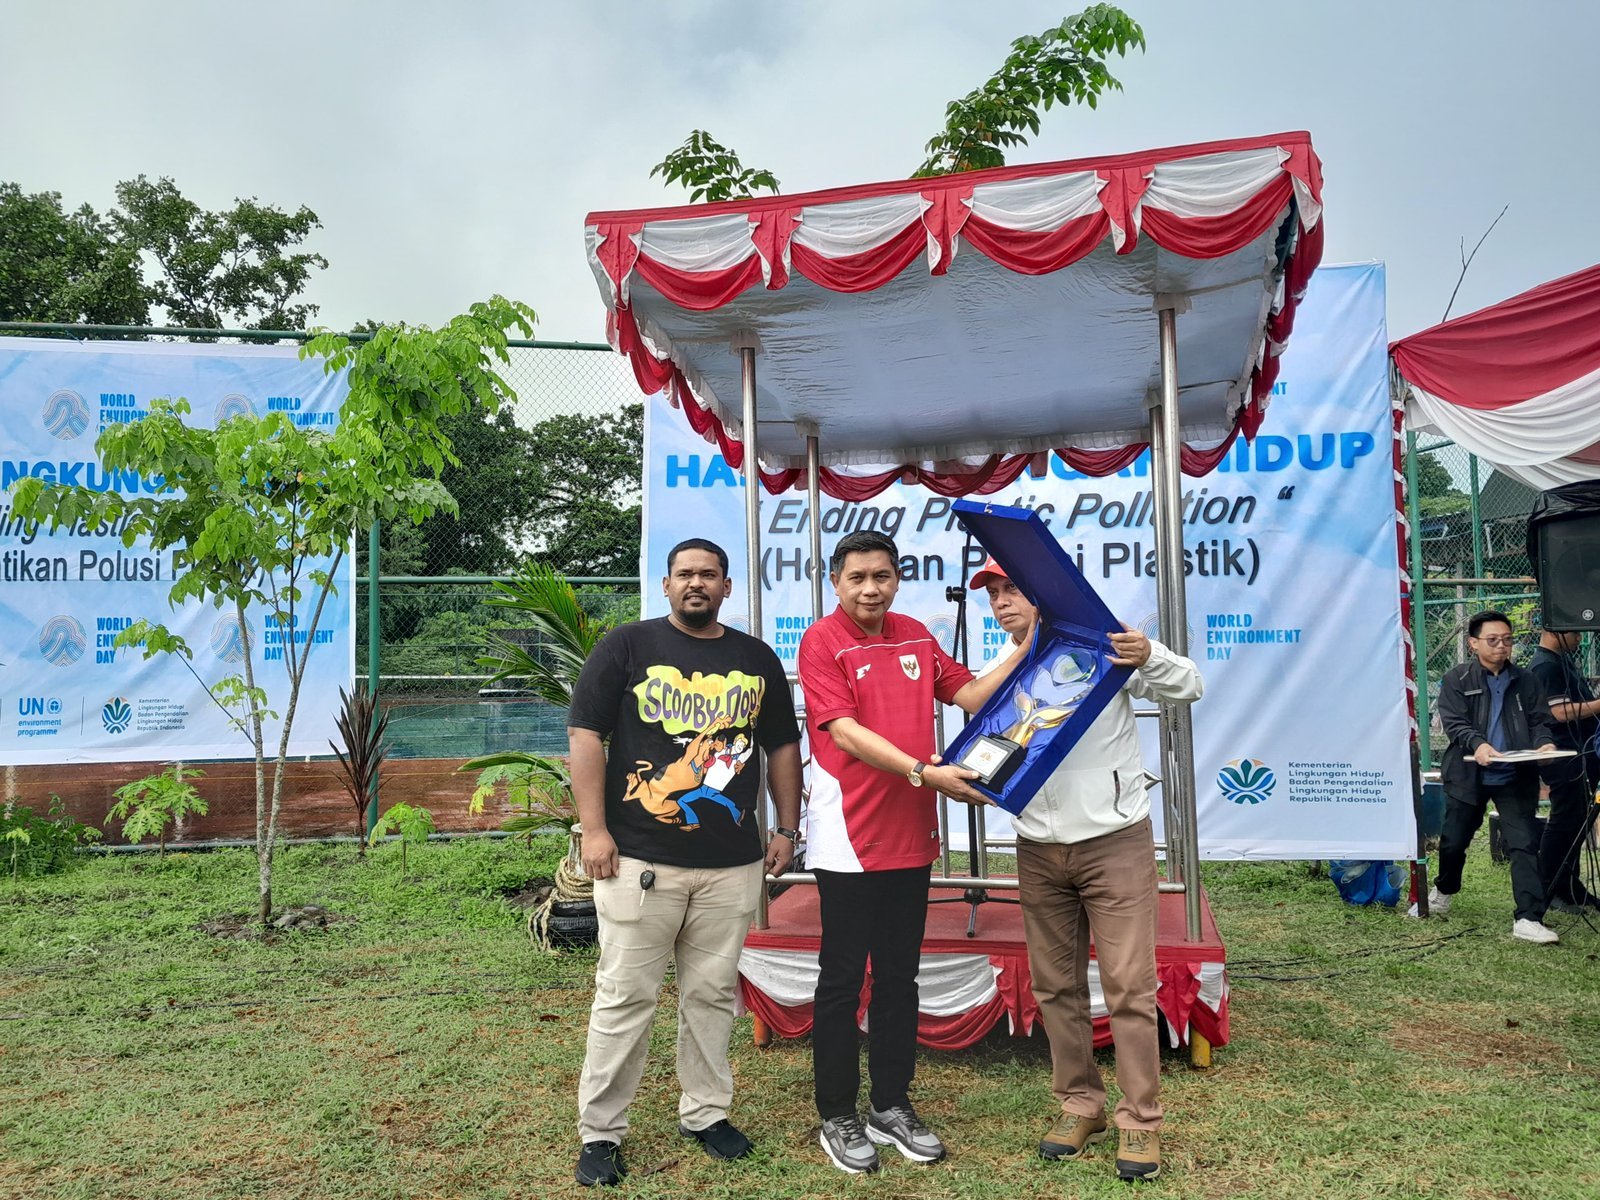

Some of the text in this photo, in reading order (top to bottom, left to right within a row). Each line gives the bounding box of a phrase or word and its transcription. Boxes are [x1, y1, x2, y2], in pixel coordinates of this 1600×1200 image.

[100, 394, 135, 407] WORLD
[267, 397, 301, 410] WORLD
[287, 412, 334, 425] RONMENT
[1217, 432, 1375, 473] IDUP
[1066, 488, 1257, 529] Polltion
[79, 550, 160, 581] Polusi
[1206, 614, 1252, 628] WORLD
[1207, 629, 1301, 644] ENVIRONMENT
[96, 650, 116, 664] DAY
[264, 646, 283, 661] DAY
[775, 647, 797, 660] DAY
[1207, 647, 1232, 660] DAY
[19, 698, 44, 715] UN
[18, 719, 62, 727] environment
[17, 729, 58, 737] programme
[1288, 770, 1385, 779] Lingkungan Hidup/
[1289, 778, 1393, 787] Badan Pengendalian
[1289, 787, 1382, 796] Lingkungan Hidup
[1289, 795, 1387, 804] Republik Indonesia
